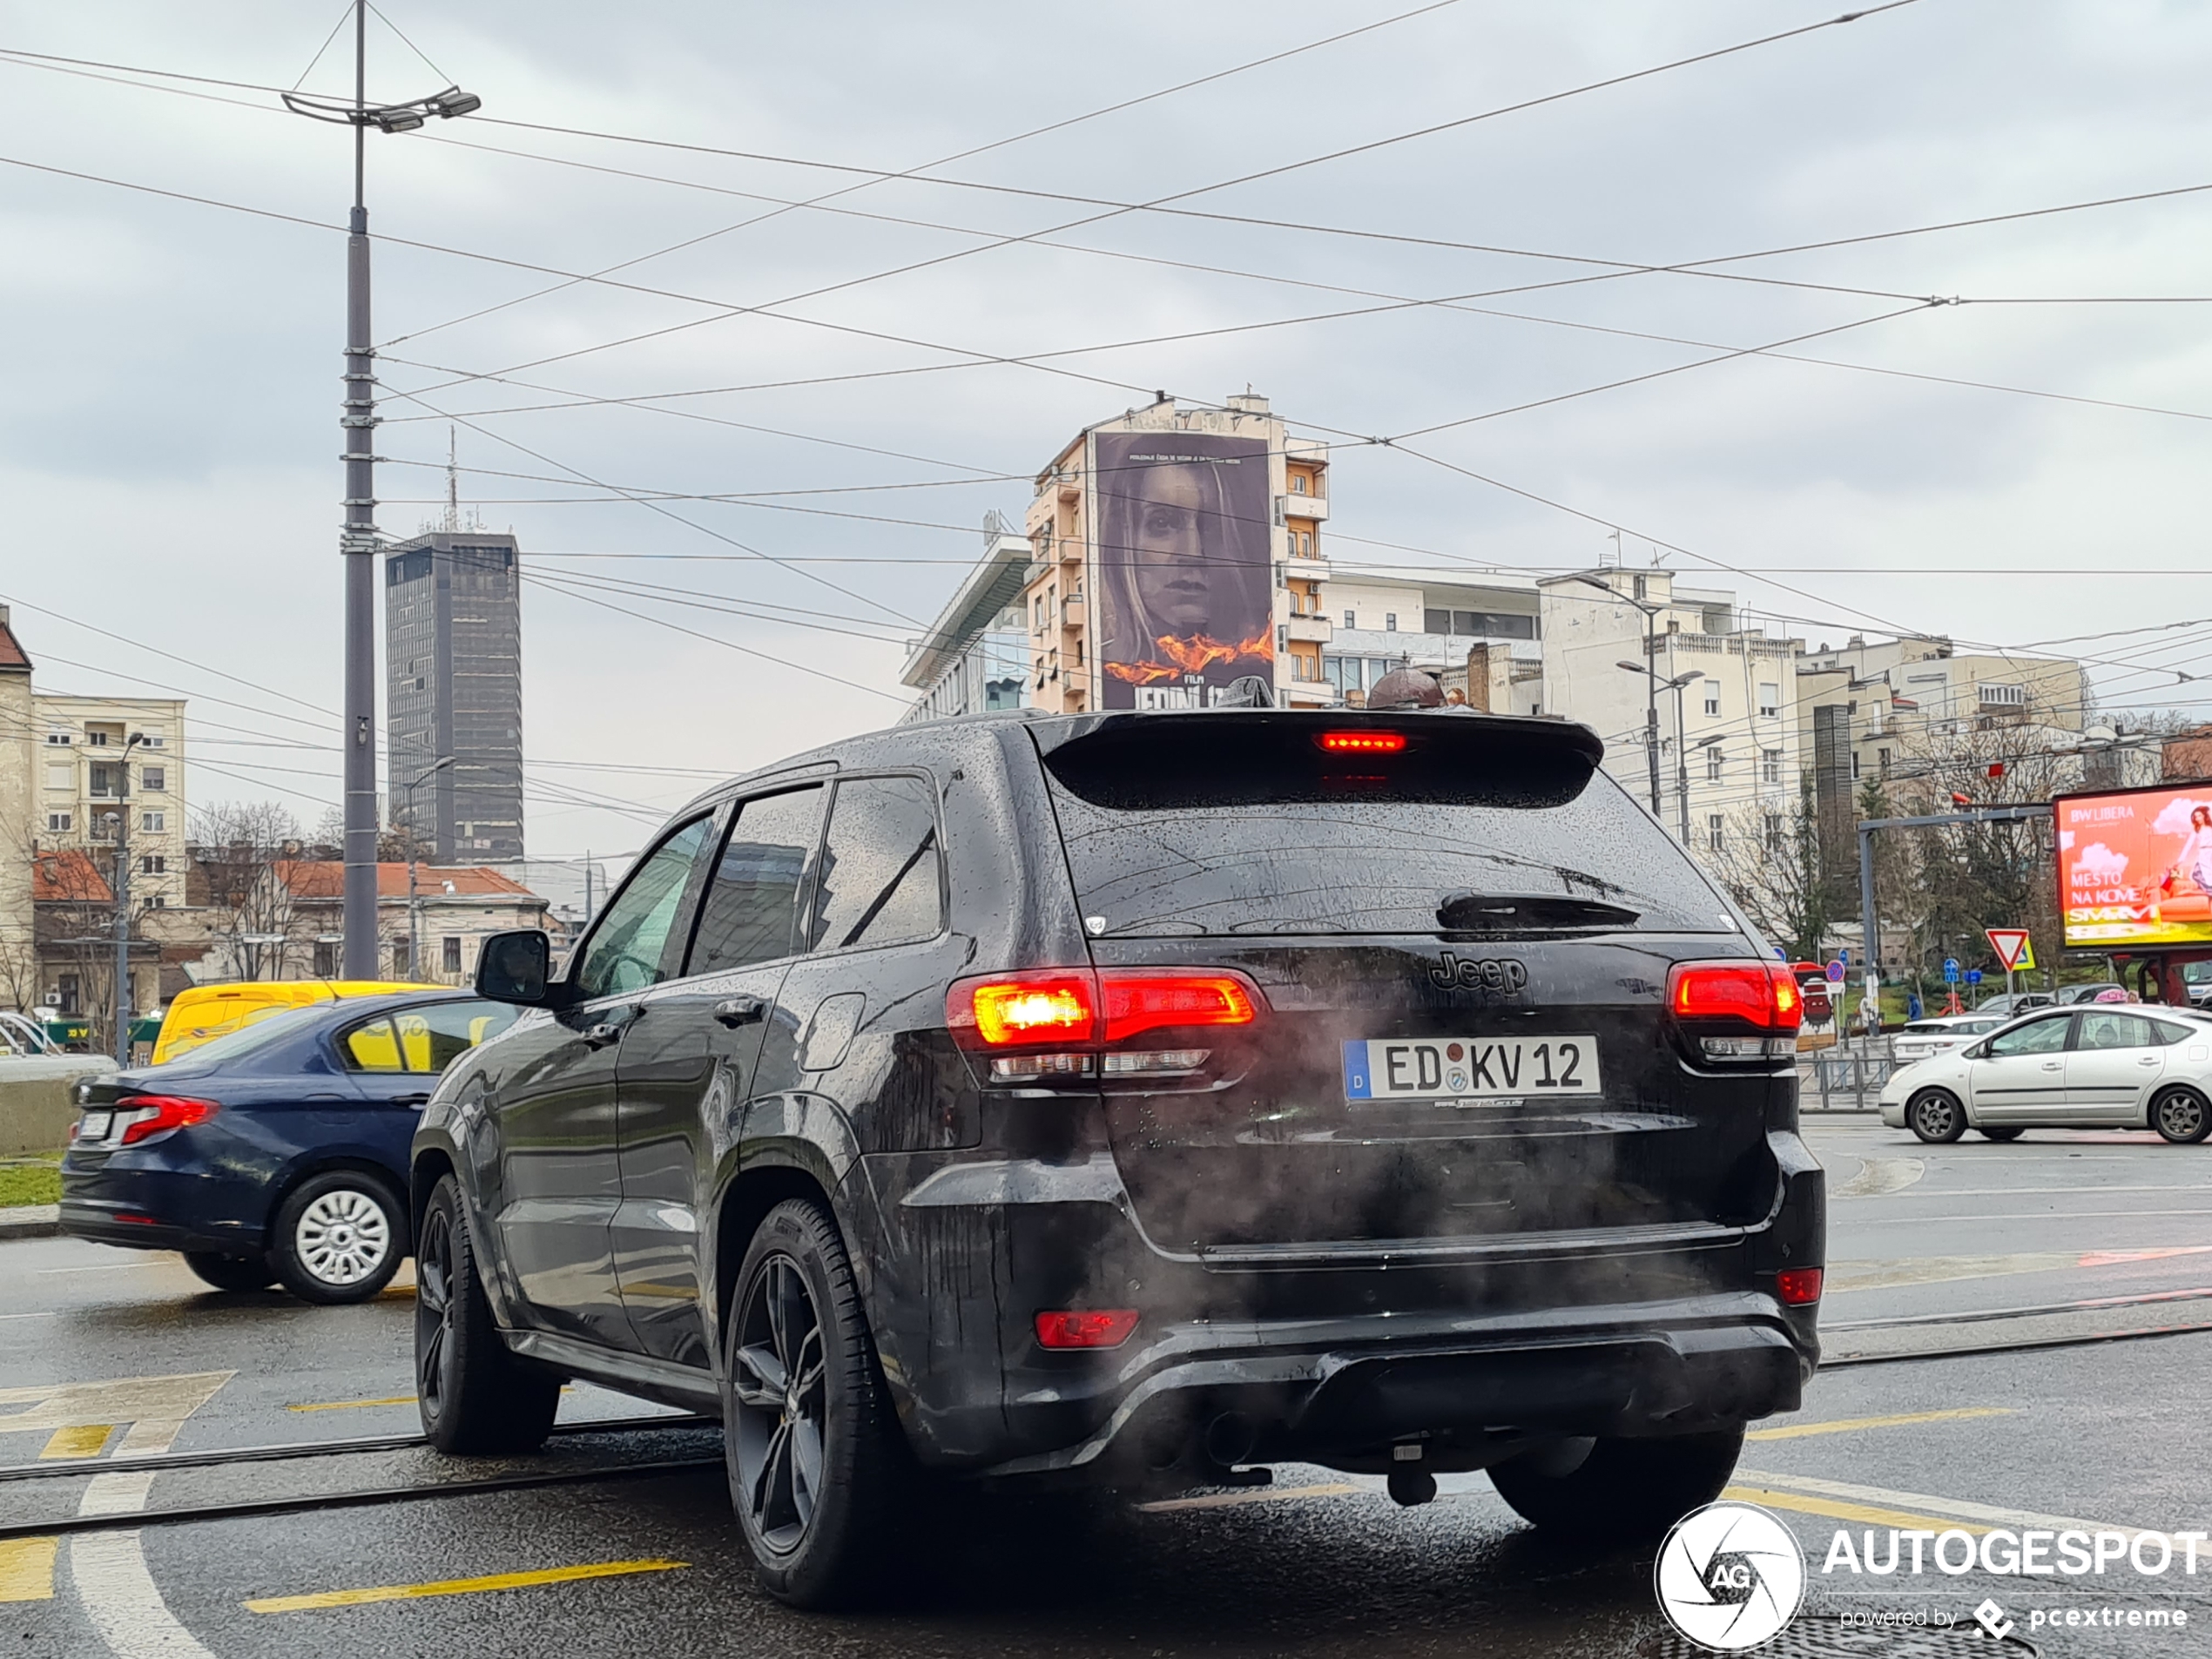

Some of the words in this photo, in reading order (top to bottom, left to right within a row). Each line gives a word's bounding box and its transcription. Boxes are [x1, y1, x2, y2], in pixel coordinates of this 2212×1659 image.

[2094, 806, 2134, 821] LIBERA
[2071, 872, 2121, 887] MESTO
[2072, 890, 2093, 904] NA
[2096, 889, 2141, 902] KOME
[1430, 951, 1526, 996] Jeep
[1386, 1045, 1441, 1090] ED
[1471, 1045, 1521, 1089] KV
[1534, 1043, 1582, 1087] 12
[1353, 1076, 1364, 1089] D
